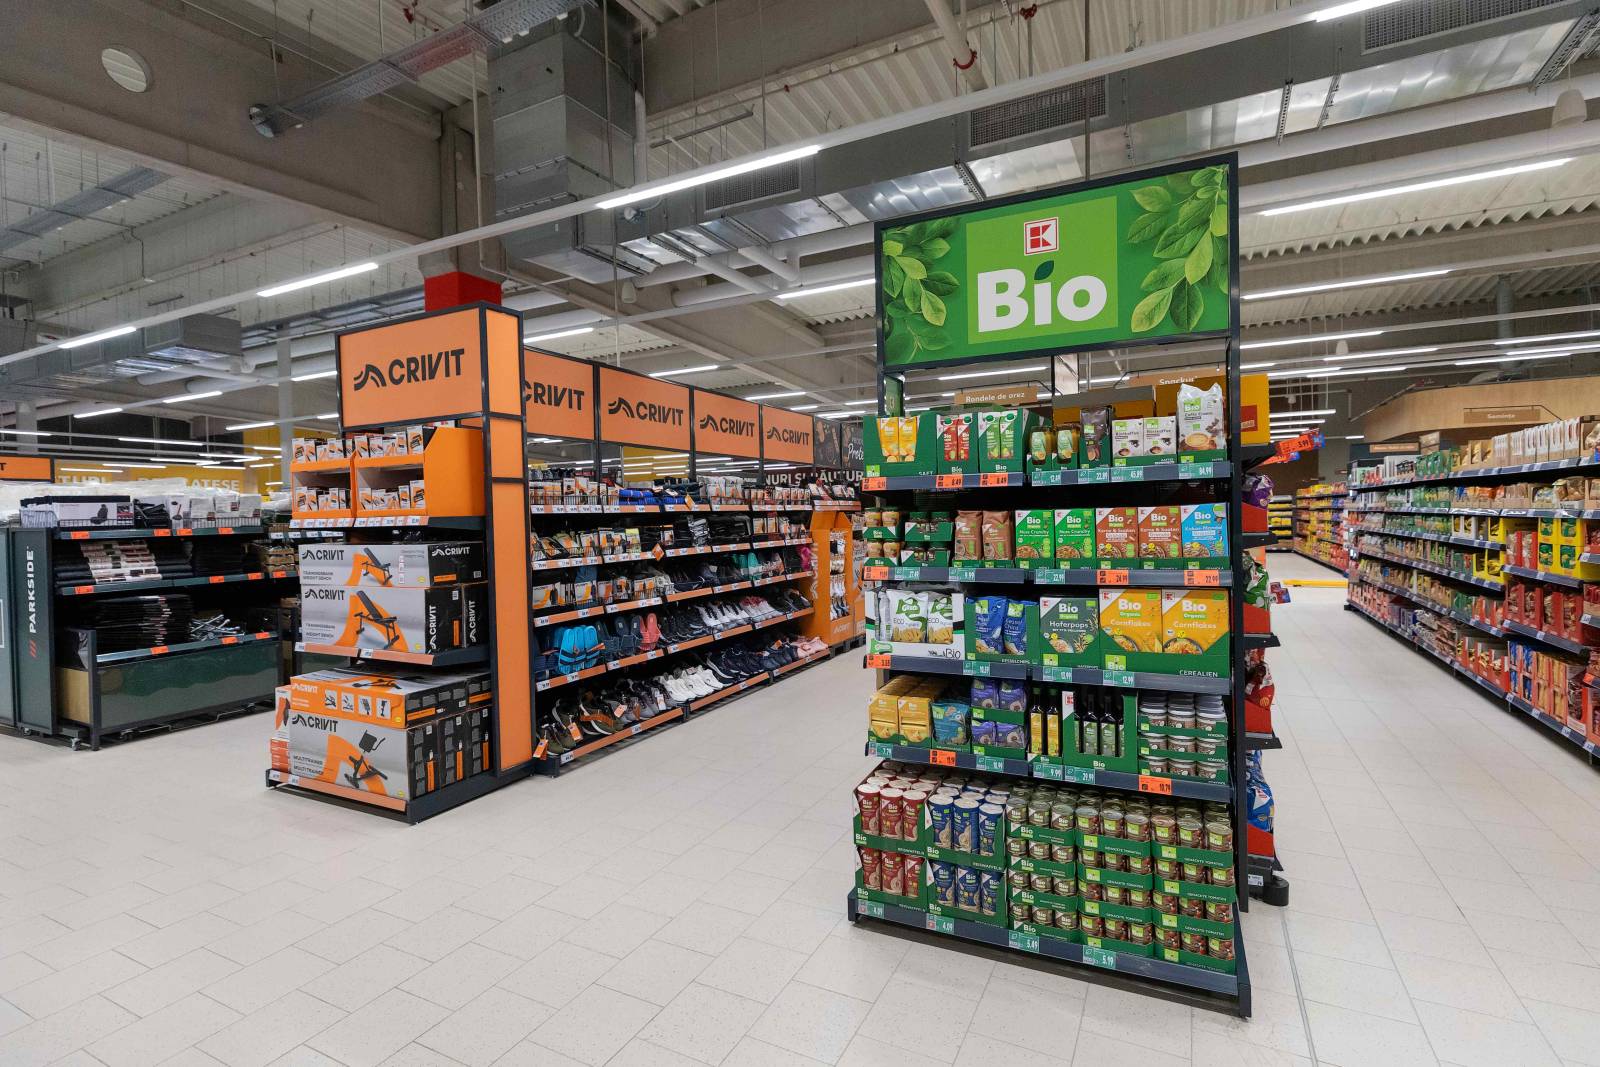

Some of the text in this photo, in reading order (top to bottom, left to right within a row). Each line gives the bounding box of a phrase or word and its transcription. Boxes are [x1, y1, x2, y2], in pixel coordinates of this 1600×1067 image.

[977, 262, 1108, 333] Bio
[388, 348, 464, 386] CRIVIT
[636, 402, 684, 426] CRIVIT
[720, 416, 754, 438] CRIVIT
[782, 428, 810, 446] CRIVIT
[1026, 516, 1040, 524] Bio
[1066, 515, 1081, 524] Bio
[1108, 514, 1124, 523] Bio
[1151, 513, 1167, 522] Bio
[1194, 512, 1211, 520] Bio
[316, 550, 344, 560] CRIVIT
[445, 546, 470, 556] CRIVIT
[26, 550, 36, 633] PARKSIDE
[318, 589, 345, 600] CRIVIT
[1059, 604, 1078, 613] Bio
[1118, 599, 1142, 611] Bio
[1182, 600, 1207, 612] Bio
[300, 684, 318, 694] CRIVIT
[308, 716, 338, 733] CRIVIT
[927, 847, 939, 855] Bio
[1024, 925, 1036, 933] Bio
